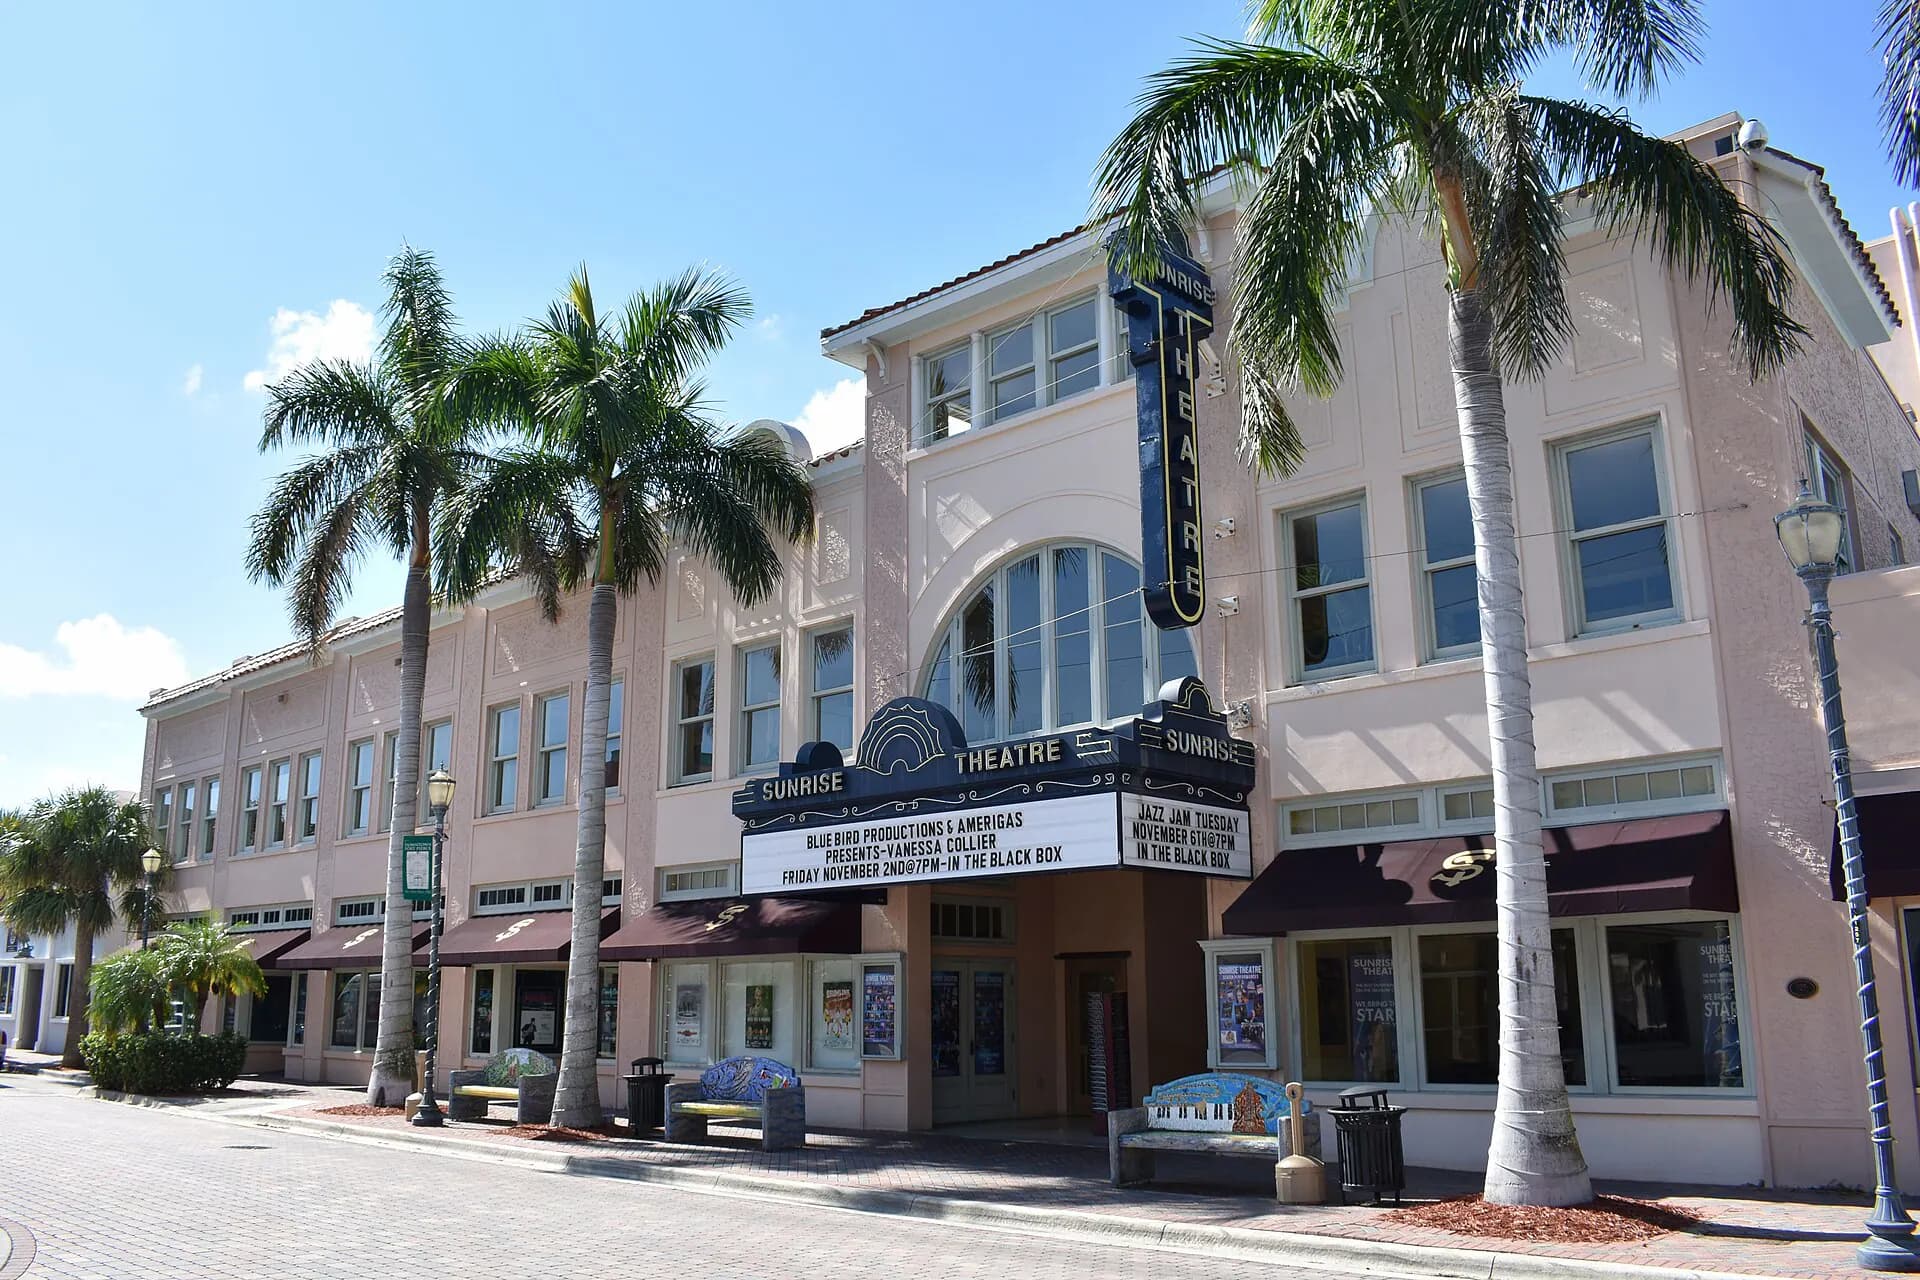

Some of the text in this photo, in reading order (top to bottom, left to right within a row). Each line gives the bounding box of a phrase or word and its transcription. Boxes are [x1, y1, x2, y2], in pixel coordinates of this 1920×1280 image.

[1157, 261, 1213, 306] UNRISE
[1173, 306, 1201, 597] THEATRE
[1166, 728, 1239, 763] SUNRISE
[763, 739, 1061, 801] SUNRISE THEATRE
[807, 811, 1023, 850] BLUE BIRD PRODUCTIONS & AMERIGAS
[1138, 803, 1239, 833] JAZZ JAM TUESDAY
[825, 833, 996, 865] PRESENTS-VANESSA COLLIER
[1132, 822, 1235, 851] NOVEMBER 6TH@7PM
[782, 867, 820, 886] FRIDAY
[822, 861, 879, 882] NOVEMBER
[964, 852, 987, 870] THE
[990, 848, 1031, 868] BLACK
[1036, 845, 1063, 864] BOX
[1137, 843, 1230, 869] IN THE BLACK BOX
[1353, 958, 1393, 968] SUNRIS
[1357, 1007, 1394, 1022] STAR
